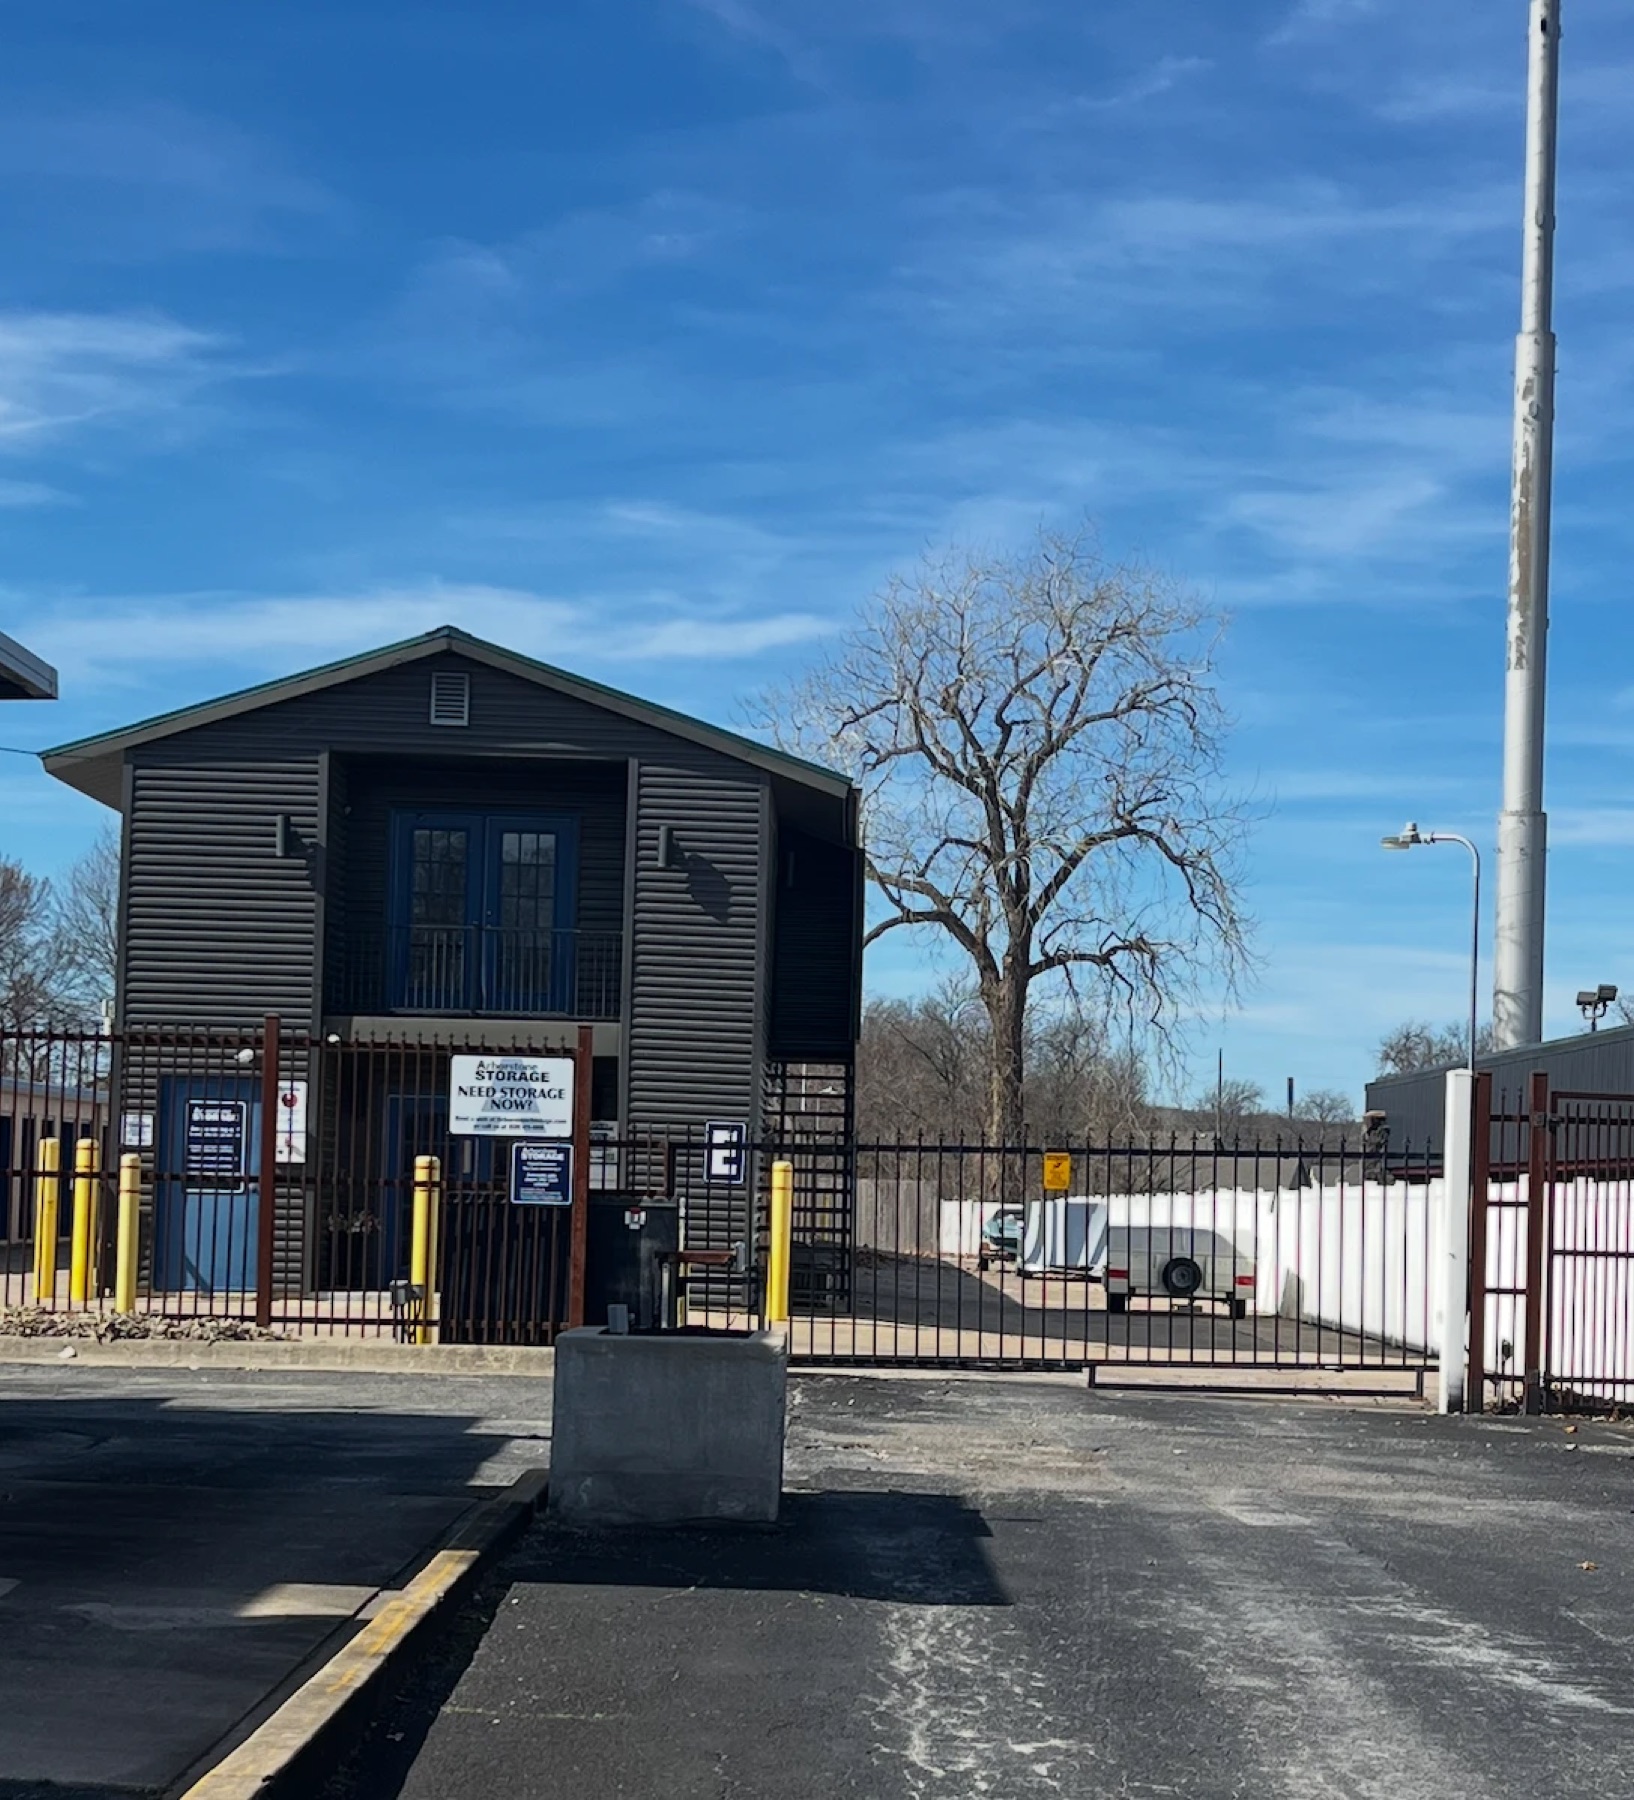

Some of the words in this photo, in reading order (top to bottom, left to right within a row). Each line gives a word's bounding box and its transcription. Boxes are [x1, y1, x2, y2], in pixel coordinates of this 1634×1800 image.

[475, 1070, 551, 1083] STORAGE
[457, 1085, 496, 1098] NEED
[500, 1087, 567, 1100] STORAGE
[490, 1099, 533, 1111] NOW?
